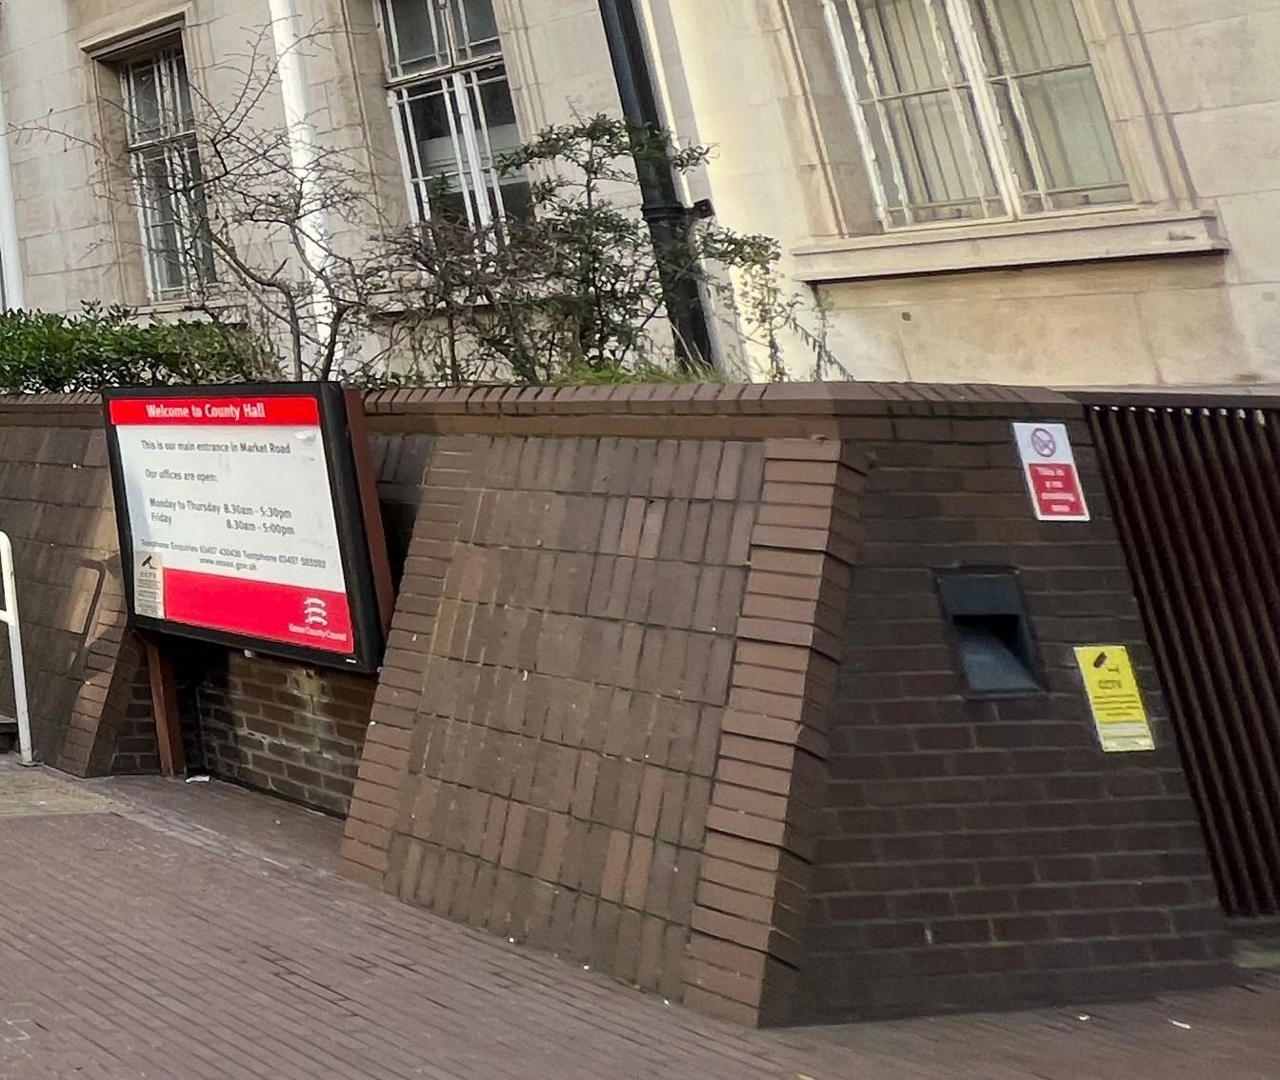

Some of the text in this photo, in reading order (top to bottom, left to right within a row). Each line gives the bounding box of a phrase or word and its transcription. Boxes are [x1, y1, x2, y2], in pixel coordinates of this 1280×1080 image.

[146, 402, 266, 421] Welcome to County Hall
[141, 440, 155, 450] This
[157, 440, 164, 450] is
[177, 442, 195, 452] main
[197, 442, 230, 453] entrance
[240, 442, 268, 454] Market
[269, 443, 291, 454] Road
[159, 469, 182, 481] offices
[149, 498, 176, 511] Monday
[177, 500, 186, 510] to
[187, 500, 221, 514] Thursday
[223, 503, 253, 515] 8.30am
[151, 512, 172, 525] Friday
